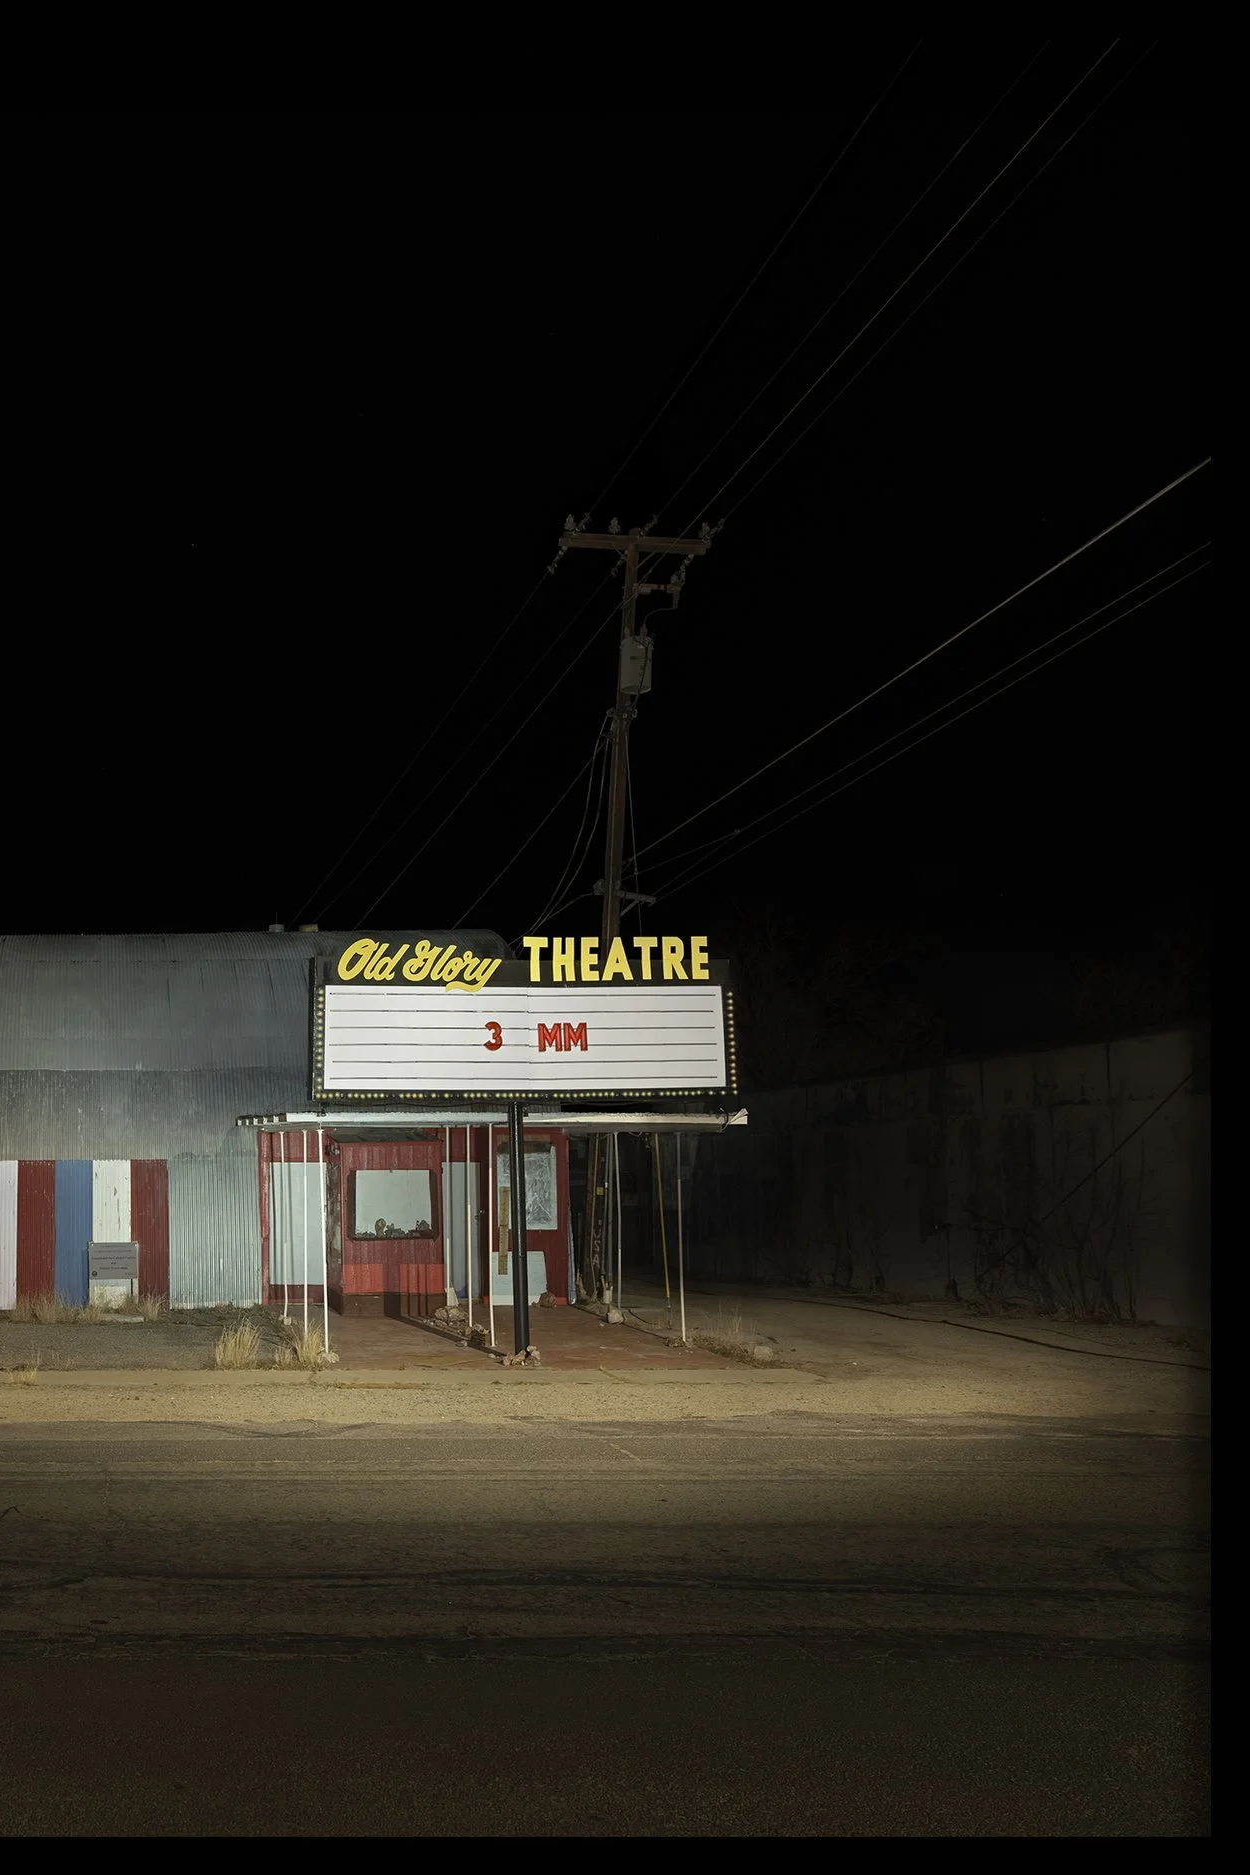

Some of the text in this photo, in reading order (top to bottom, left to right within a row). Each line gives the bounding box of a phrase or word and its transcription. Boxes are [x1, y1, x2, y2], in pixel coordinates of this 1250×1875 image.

[337, 936, 710, 992] Old Glory THEATRE
[483, 1021, 589, 1052] 3 MM
